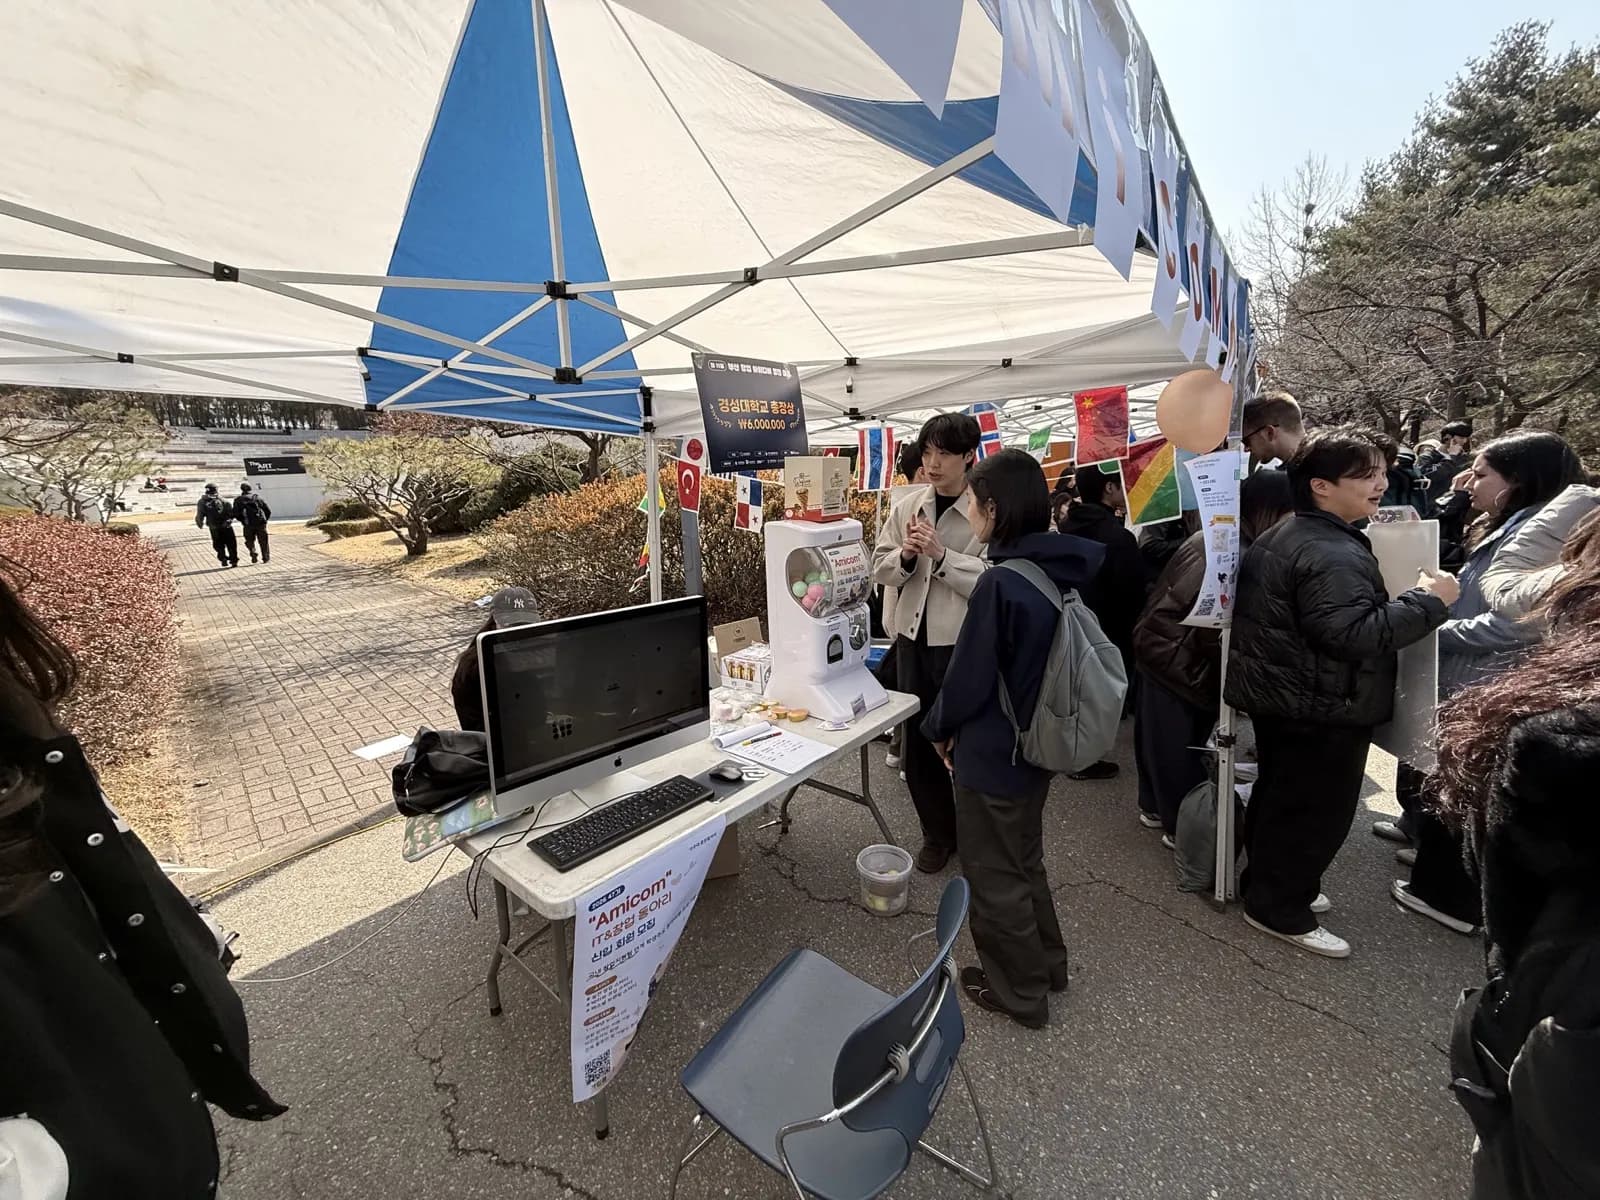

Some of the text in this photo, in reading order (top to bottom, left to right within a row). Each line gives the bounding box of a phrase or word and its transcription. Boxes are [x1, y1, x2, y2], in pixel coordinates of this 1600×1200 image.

[718, 398, 795, 415] 경성대학교 총장상
[513, 598, 525, 609] NY
[588, 869, 672, 931] "Amicom"
[592, 913, 635, 948] IT&창업
[638, 891, 672, 920] 동아리
[591, 917, 656, 963] 신입 회원 모집
